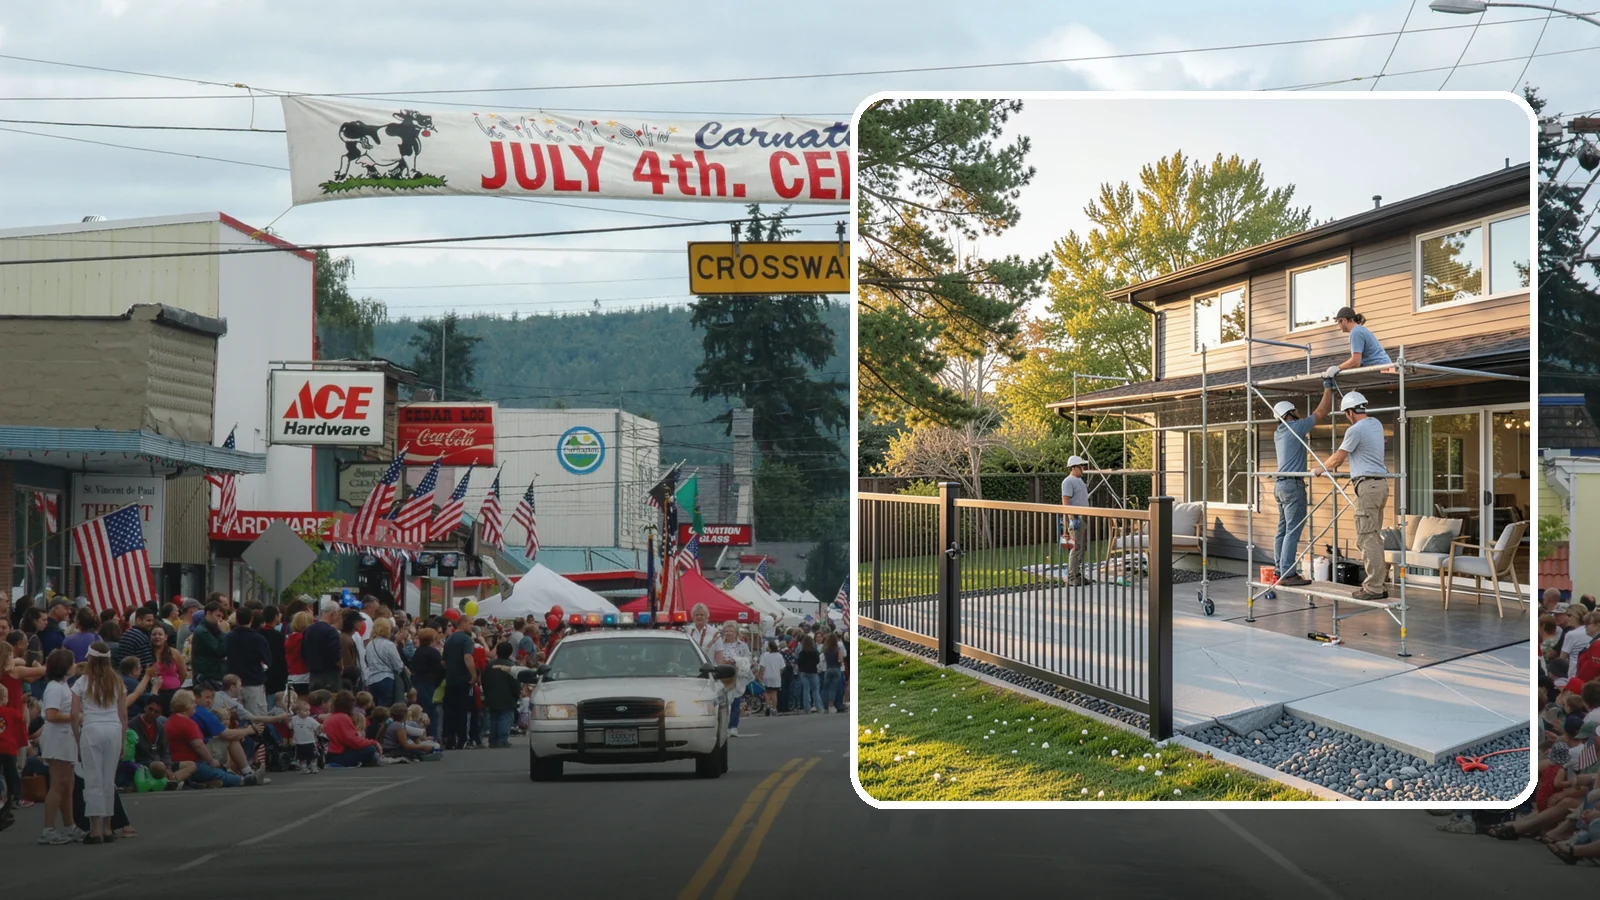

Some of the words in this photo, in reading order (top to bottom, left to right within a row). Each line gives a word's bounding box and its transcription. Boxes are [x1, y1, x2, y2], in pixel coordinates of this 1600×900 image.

[481, 141, 604, 192] JULY
[632, 150, 747, 198] 4th.
[697, 254, 850, 280] CROSSWA
[283, 380, 373, 420] ACE
[405, 409, 452, 422] CEDAR
[461, 409, 485, 421] LOG
[283, 421, 371, 436] Hardware
[416, 428, 477, 447] Coca-Cola
[95, 485, 124, 495] Vincent
[126, 486, 135, 495] de
[137, 486, 155, 495] Paul
[699, 535, 730, 543] GLASS
